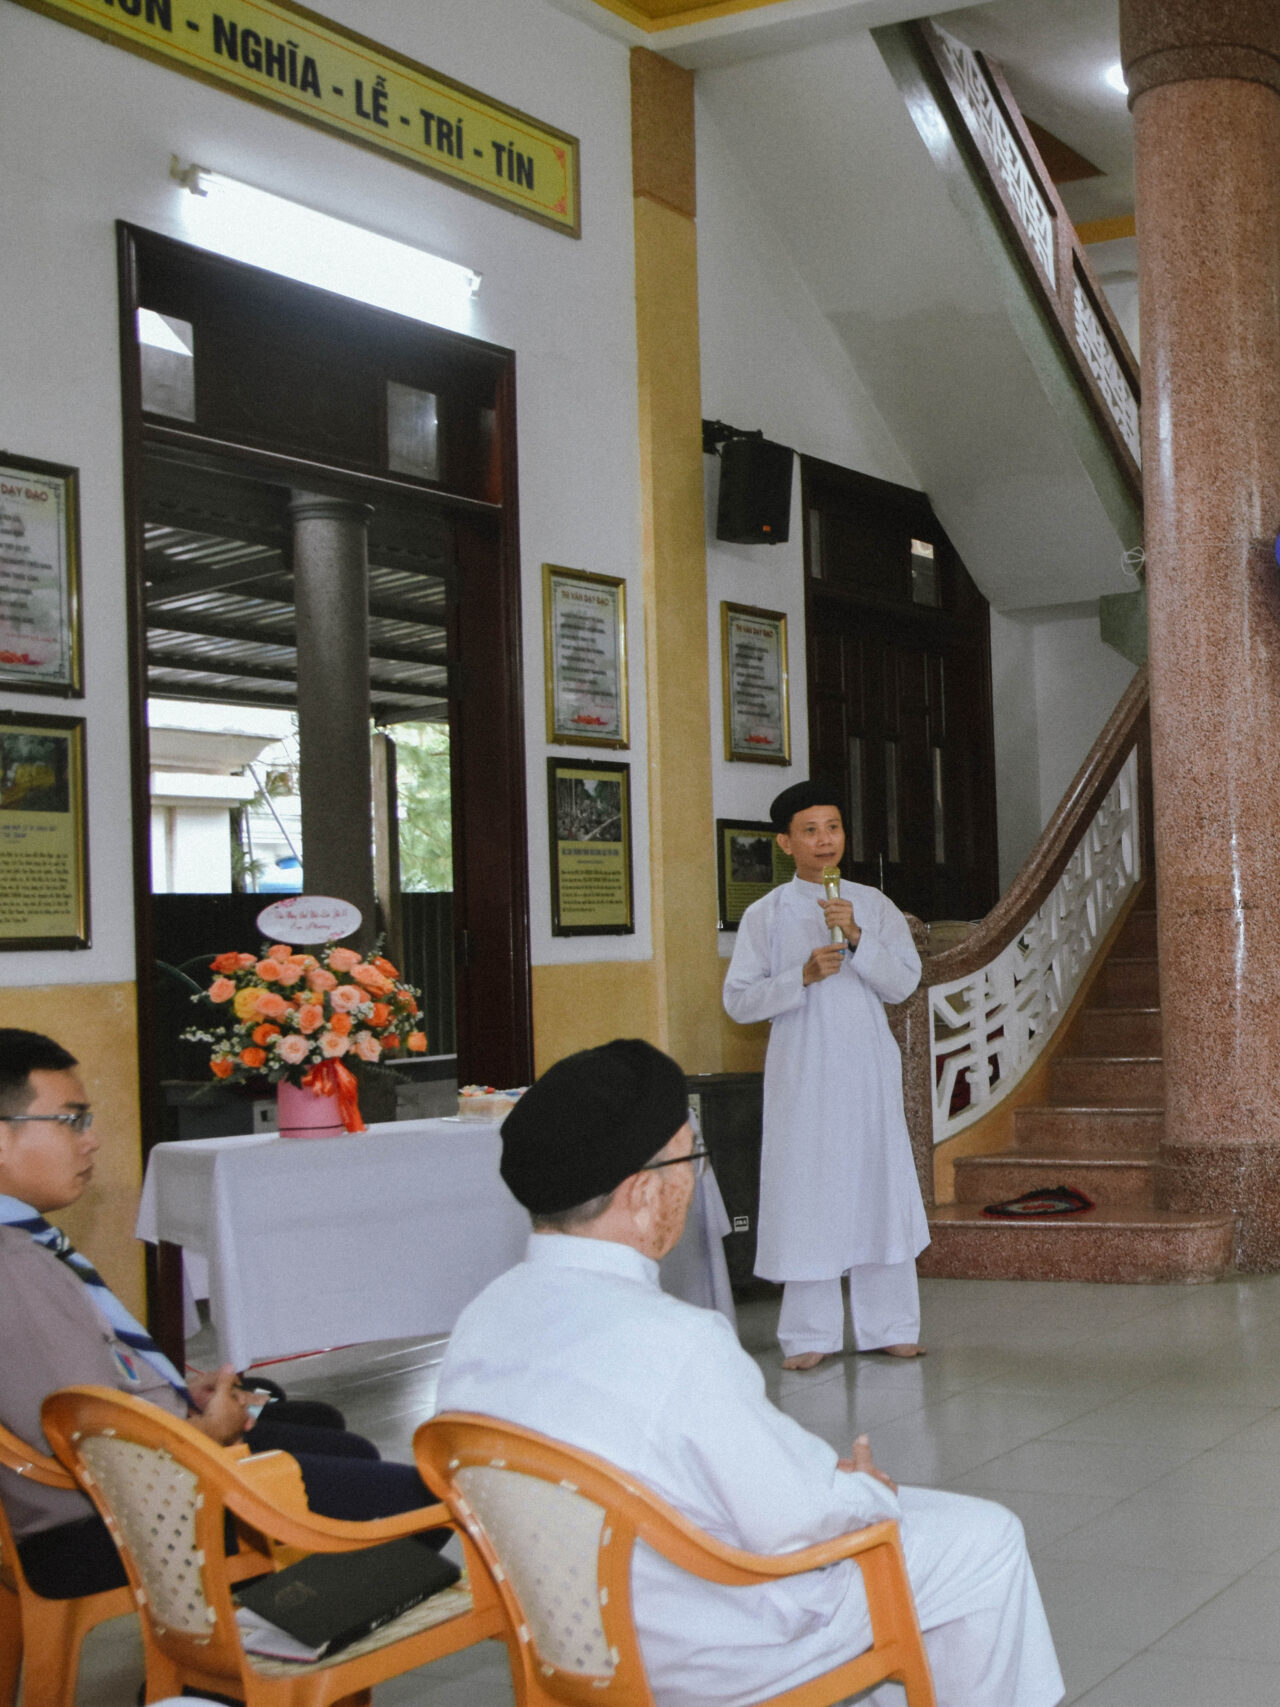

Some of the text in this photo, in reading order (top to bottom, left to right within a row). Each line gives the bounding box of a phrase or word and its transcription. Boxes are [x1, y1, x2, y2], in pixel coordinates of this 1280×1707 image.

[212, 12, 322, 99] NGHĨA
[355, 74, 389, 128] LỄ
[419, 107, 464, 160] TRÍ
[491, 140, 534, 190] TÍN
